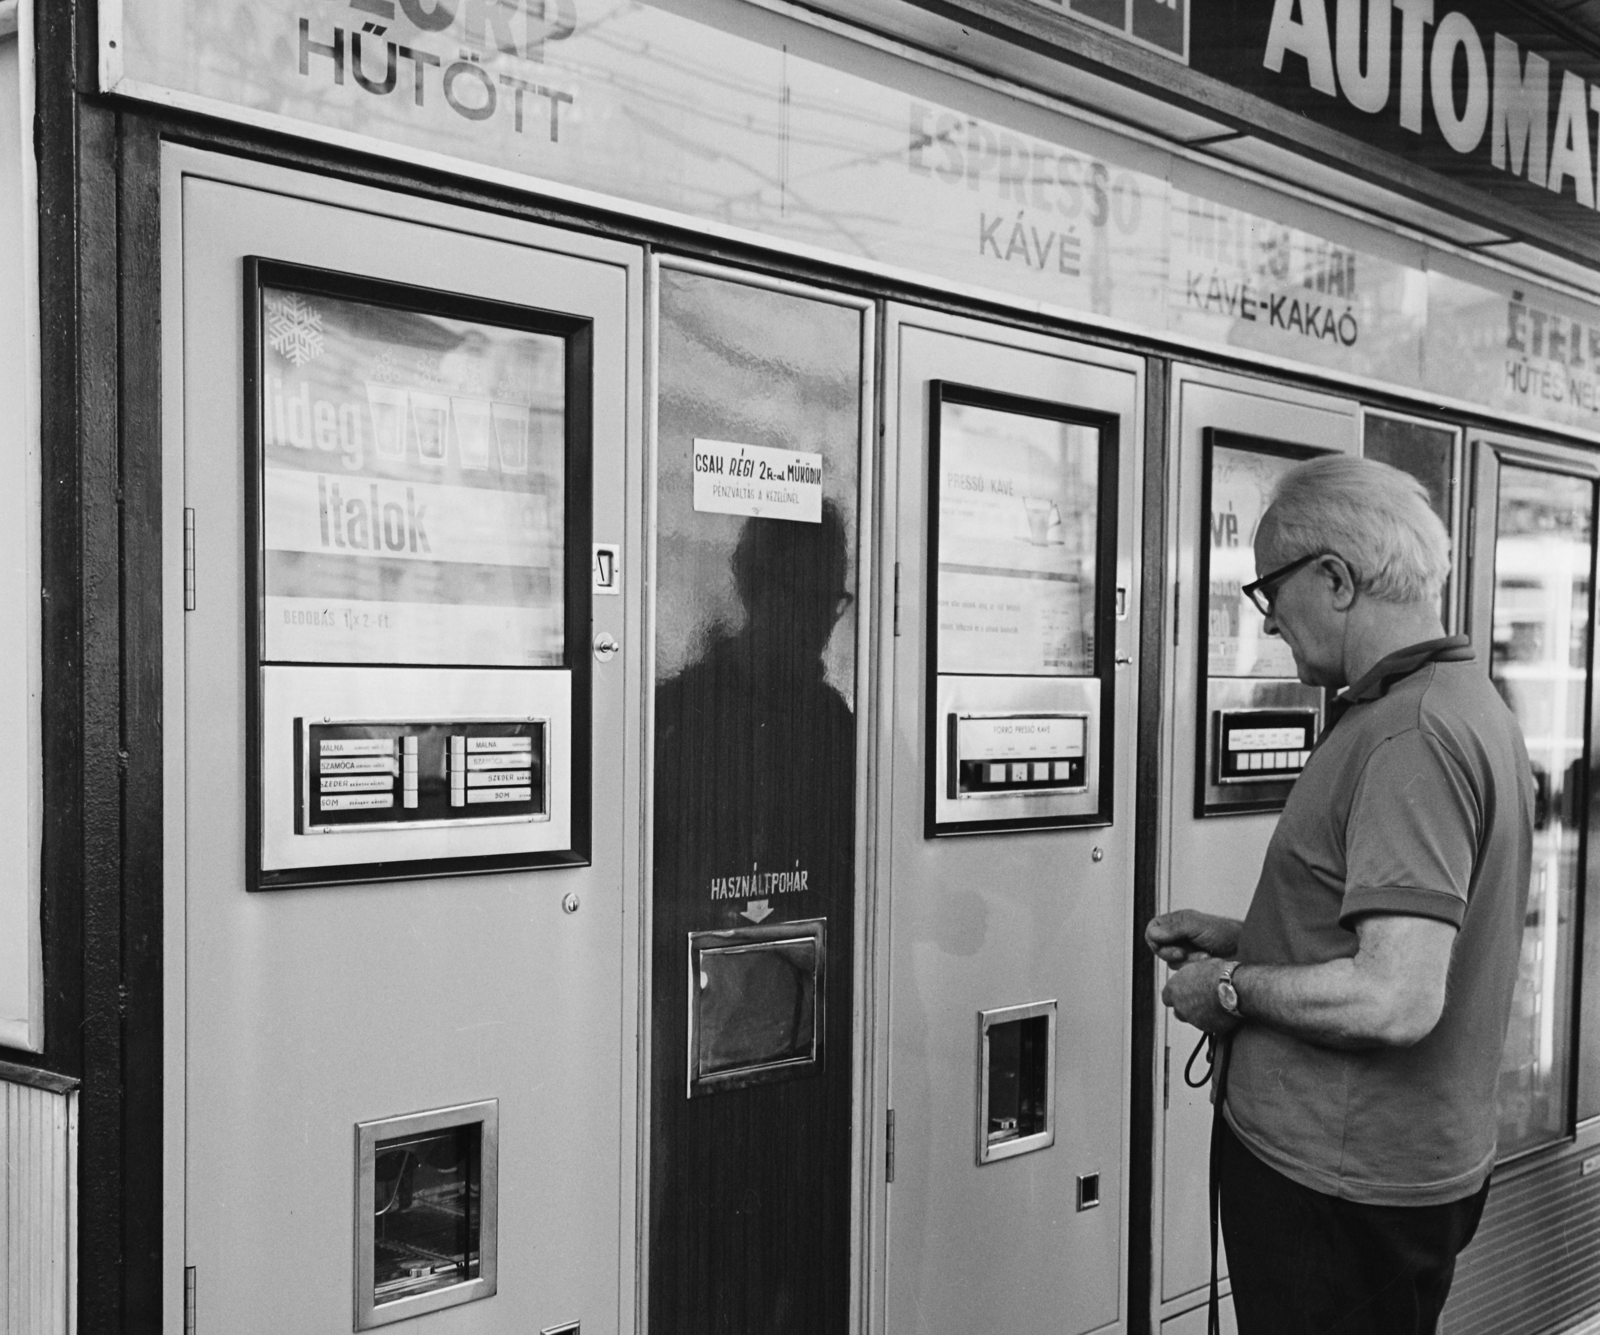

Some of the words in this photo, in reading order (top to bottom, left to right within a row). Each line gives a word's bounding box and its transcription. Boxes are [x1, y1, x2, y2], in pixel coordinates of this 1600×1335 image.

[298, 17, 574, 143] HŰTÖTT
[1263, 0, 1600, 212] AUTOMA
[909, 101, 1141, 237] ESPRESSO
[980, 210, 1081, 276] KÁVÉ
[1186, 267, 1358, 347] KÁVÉ-KAKAÓ
[695, 453, 724, 475] CSAK
[728, 447, 755, 478] RÉGI
[317, 475, 432, 553] Italok
[712, 480, 755, 500] PÉNZVÁLTÁS
[284, 609, 336, 628] BEDOBÁS
[321, 760, 355, 770] SZAMÓCA
[321, 798, 339, 807] SOM
[494, 791, 511, 800] SOM
